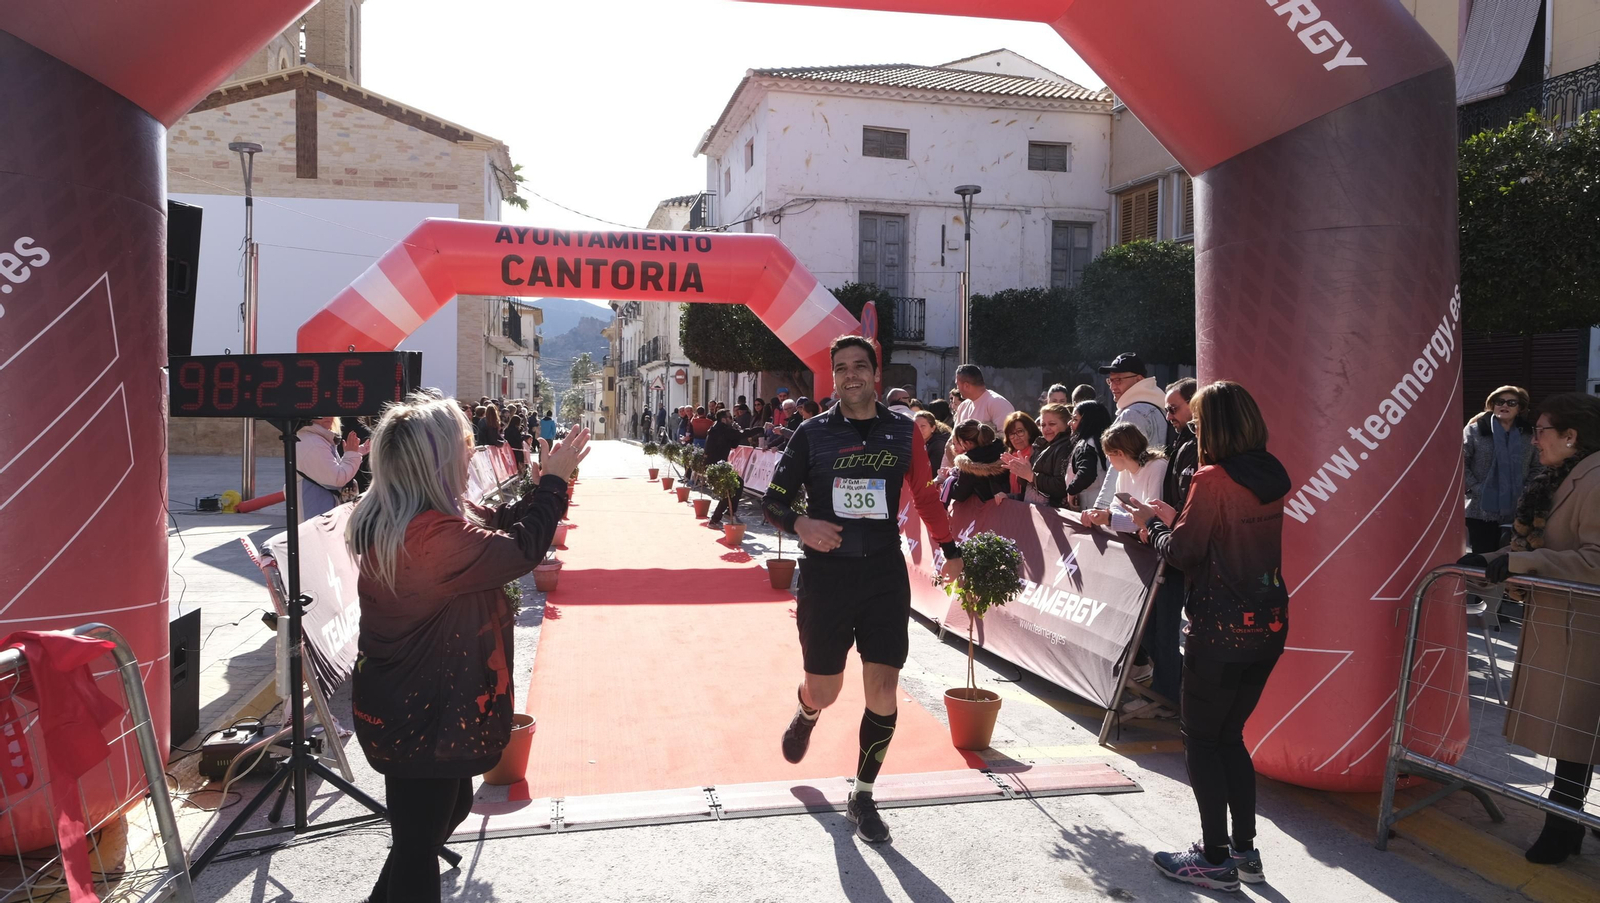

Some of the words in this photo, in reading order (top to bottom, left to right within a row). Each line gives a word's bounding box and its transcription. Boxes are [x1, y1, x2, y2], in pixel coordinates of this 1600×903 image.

[1266, 0, 1368, 71] RGY
[495, 226, 712, 252] AYUNTAMIENTO
[501, 254, 704, 293] CANTORIA
[1283, 284, 1462, 524] www.teamergy.es
[843, 492, 876, 509] 336
[321, 597, 361, 657] TEAMER
